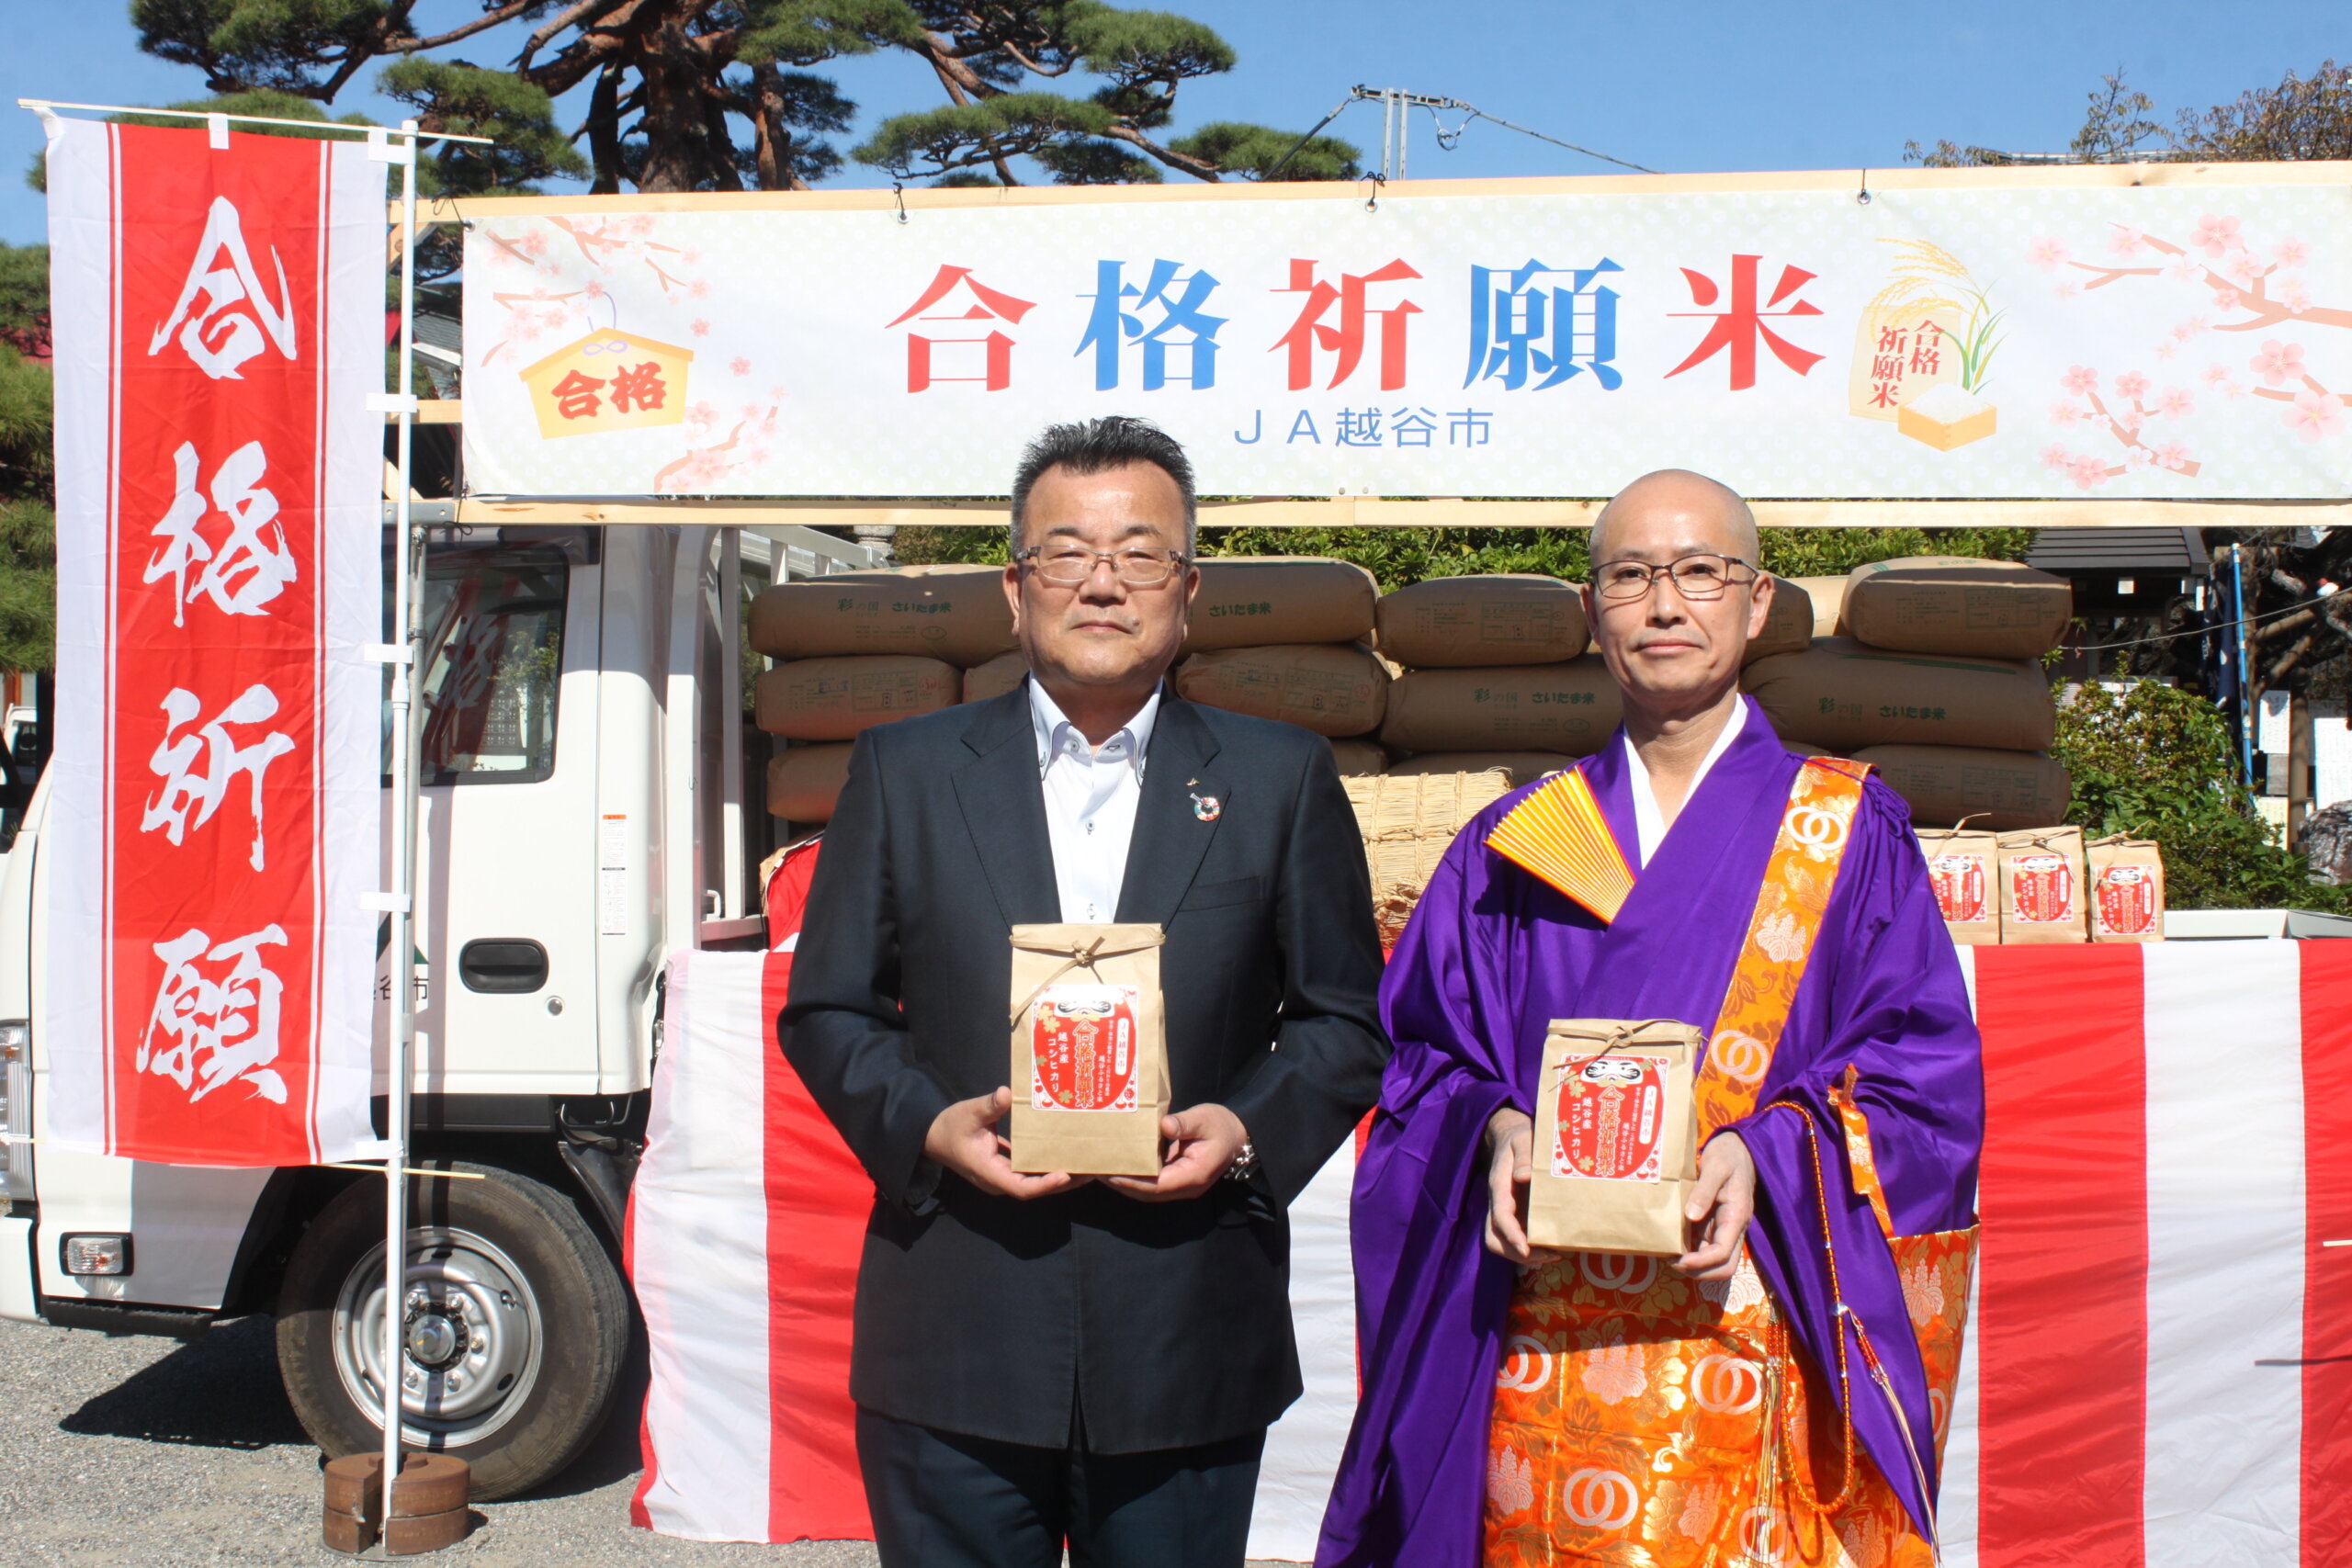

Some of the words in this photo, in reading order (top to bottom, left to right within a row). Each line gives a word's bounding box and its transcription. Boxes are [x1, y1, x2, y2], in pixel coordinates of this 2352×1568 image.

[887, 254, 1825, 393] 合格祈願米
[1907, 320, 1946, 376] 合格
[551, 361, 666, 420] 合格
[1867, 325, 1908, 408] 祈願米
[1234, 407, 1494, 448] JA越谷市
[137, 196, 297, 1104] 合格祈願
[1048, 1038, 1059, 1093] コシヒカリ
[1058, 1032, 1069, 1063] 越谷産
[1072, 1019, 1100, 1108] 合格祈願米
[1571, 1102, 1581, 1159] コシヒカリ
[1581, 1097, 1593, 1130] 越谷産
[1595, 1085, 1625, 1177] 合格祈願米
